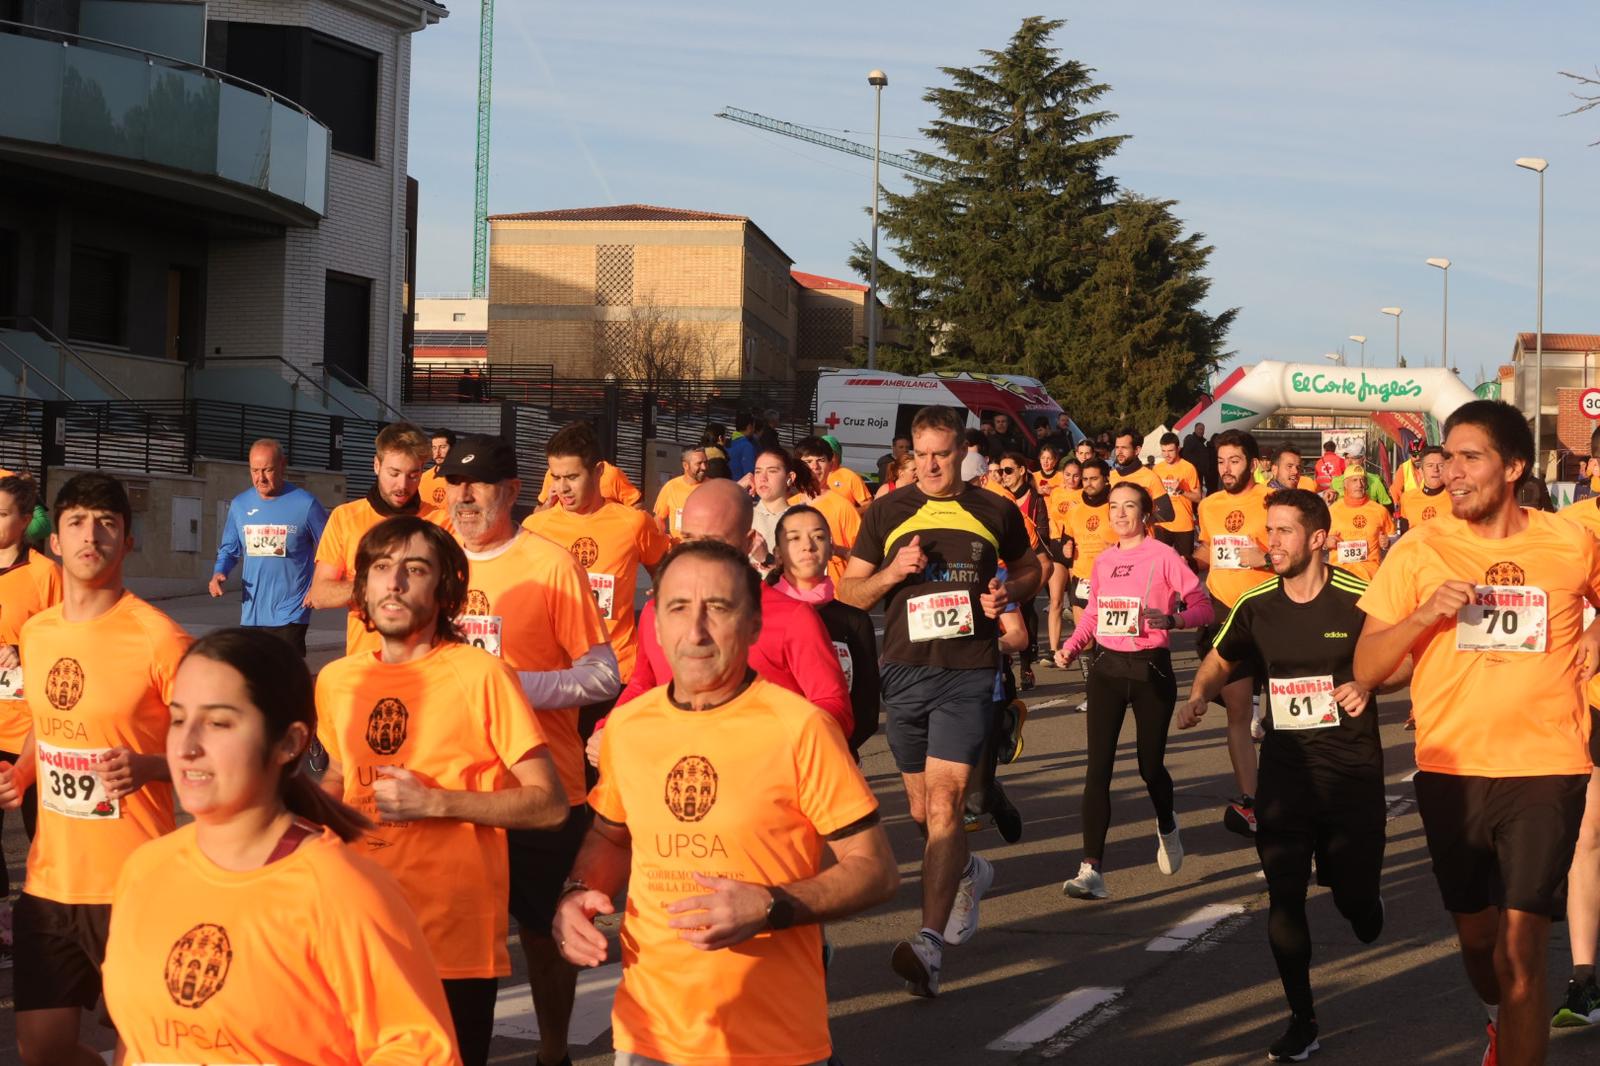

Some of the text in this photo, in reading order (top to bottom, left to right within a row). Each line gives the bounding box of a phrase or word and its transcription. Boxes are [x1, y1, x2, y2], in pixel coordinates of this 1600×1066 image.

[882, 379, 938, 388] AMBULANCIA
[1292, 372, 1422, 402] El Corte Inglés
[1586, 398, 1600, 409] 30
[843, 416, 889, 429] Cruz Roja
[1344, 548, 1361, 558] 383
[1475, 591, 1545, 607] edunia
[1106, 610, 1128, 626] 277
[1483, 609, 1518, 635] 70
[1271, 679, 1333, 695] bedunia
[1289, 696, 1313, 717] 61
[39, 717, 89, 742] UPSA
[50, 770, 95, 801] 389
[655, 833, 728, 858] UPSA
[648, 870, 694, 880] CORREMO
[151, 1015, 239, 1055] UPSA
